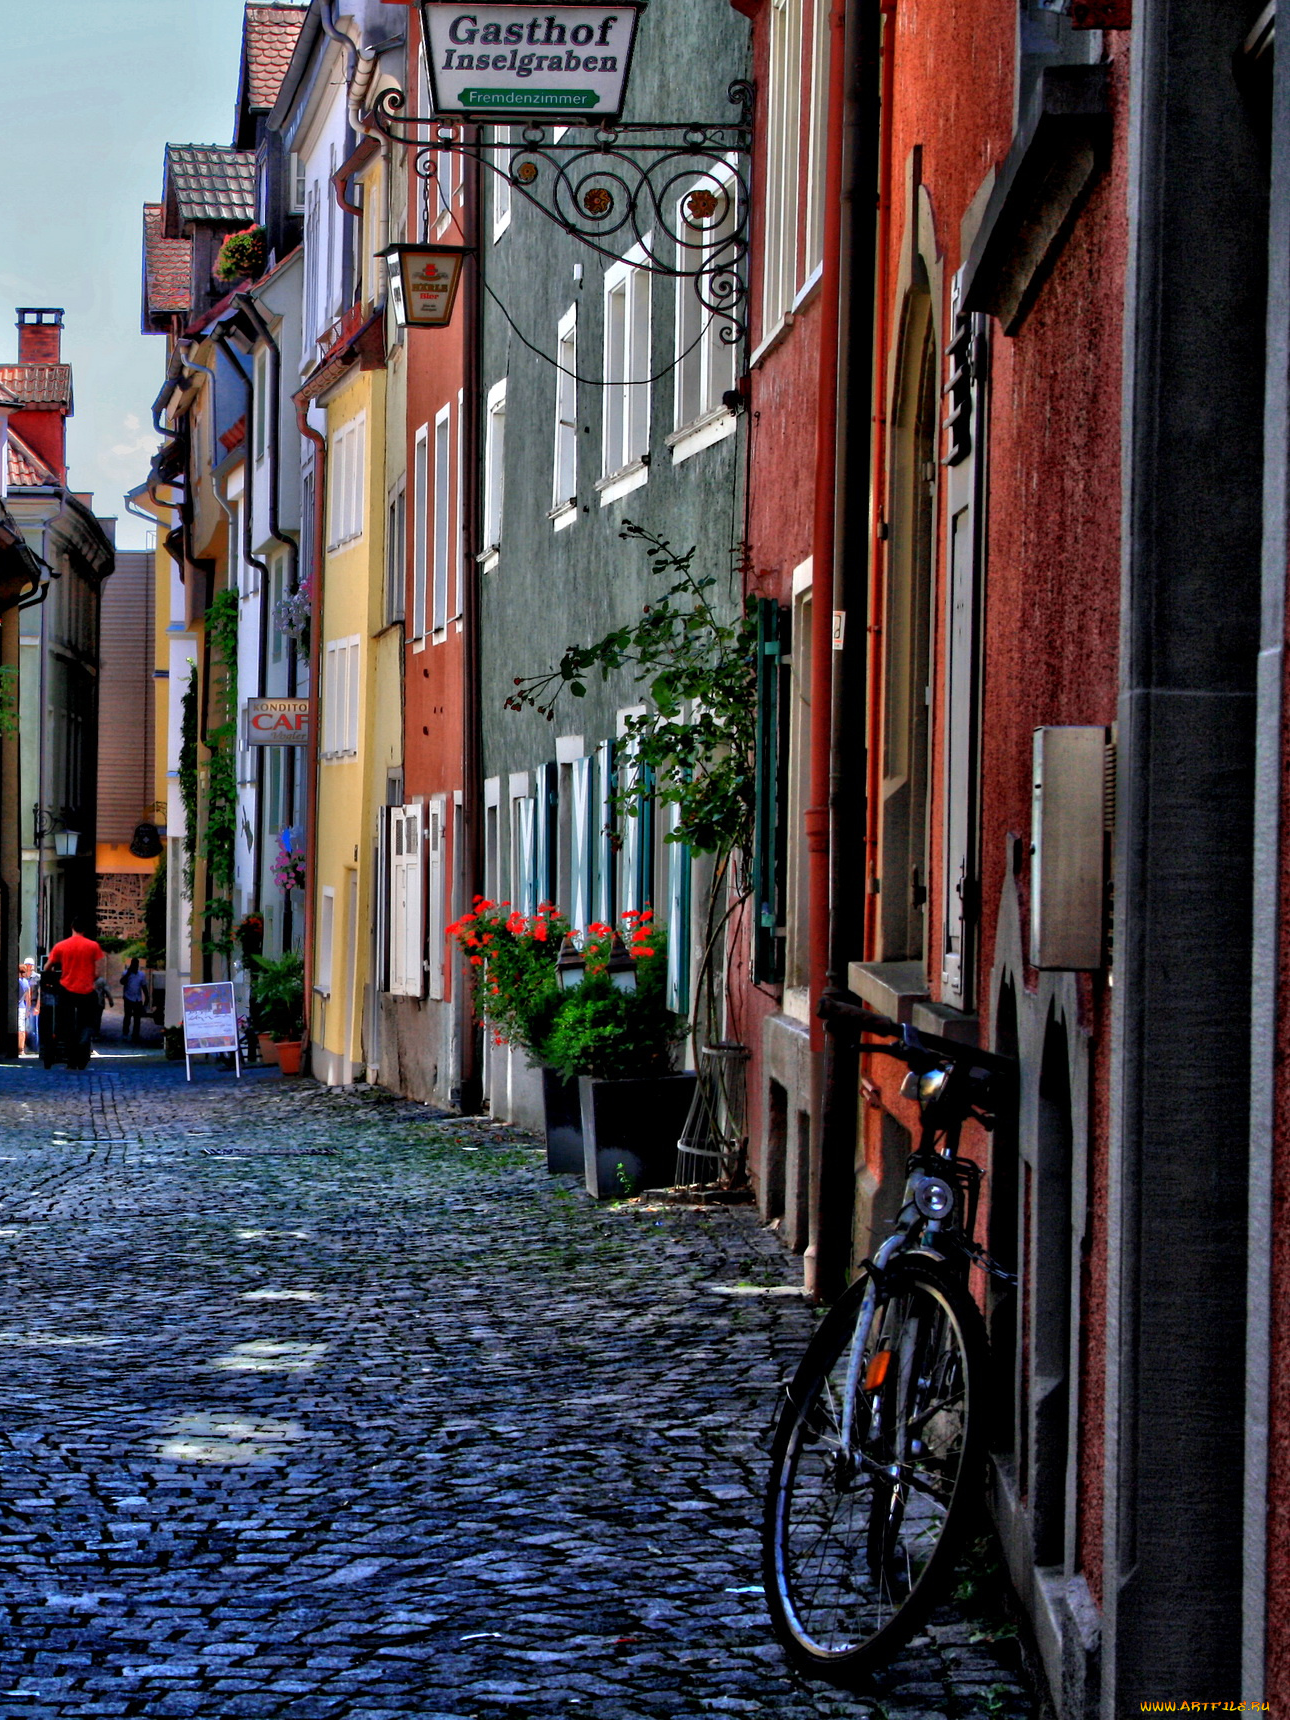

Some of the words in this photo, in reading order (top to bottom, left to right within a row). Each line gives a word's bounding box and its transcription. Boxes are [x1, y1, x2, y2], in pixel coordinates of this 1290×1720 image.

[448, 14, 618, 47] Gasthof
[441, 48, 618, 78] Inselgraben
[468, 90, 588, 105] Fremdenzimmer
